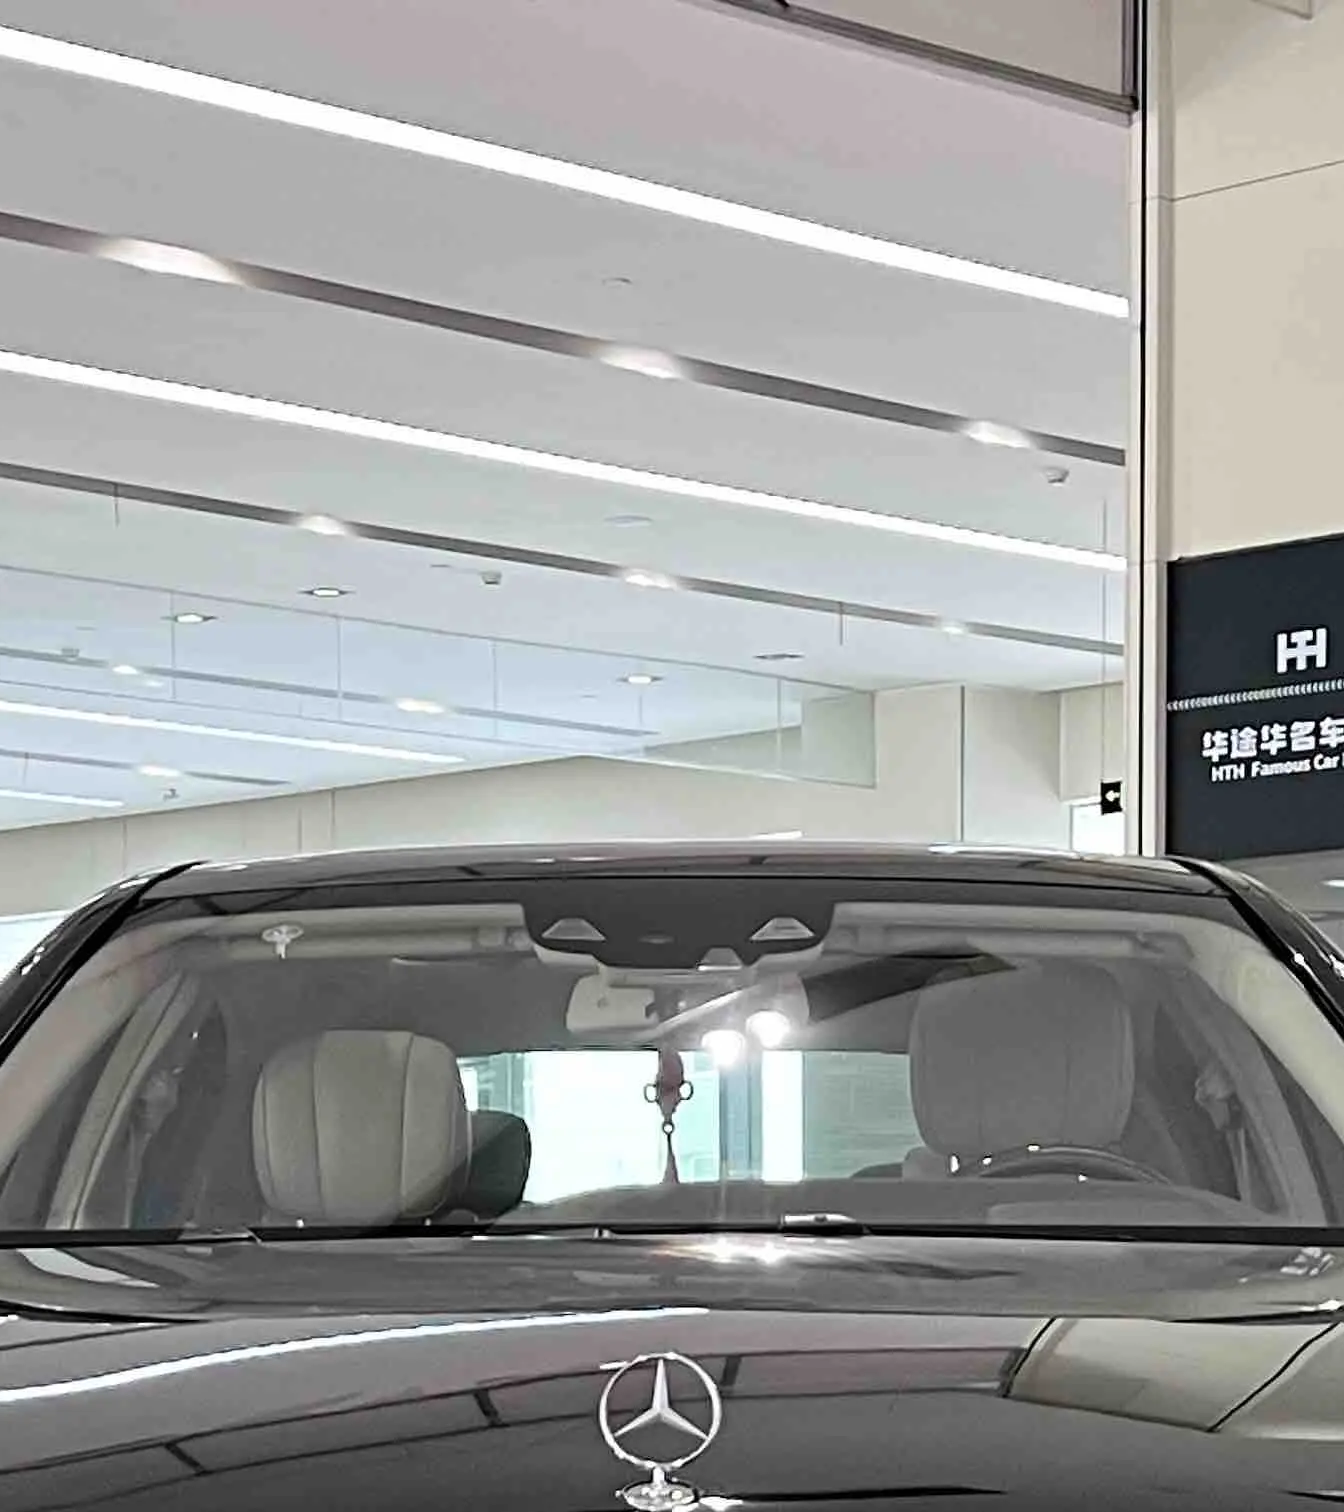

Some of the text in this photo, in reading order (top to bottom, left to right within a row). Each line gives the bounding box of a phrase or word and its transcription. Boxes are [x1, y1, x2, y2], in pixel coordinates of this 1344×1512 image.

[1211, 764, 1245, 782] HTH
[1251, 758, 1311, 777] Famous
[1313, 753, 1340, 771] Car
